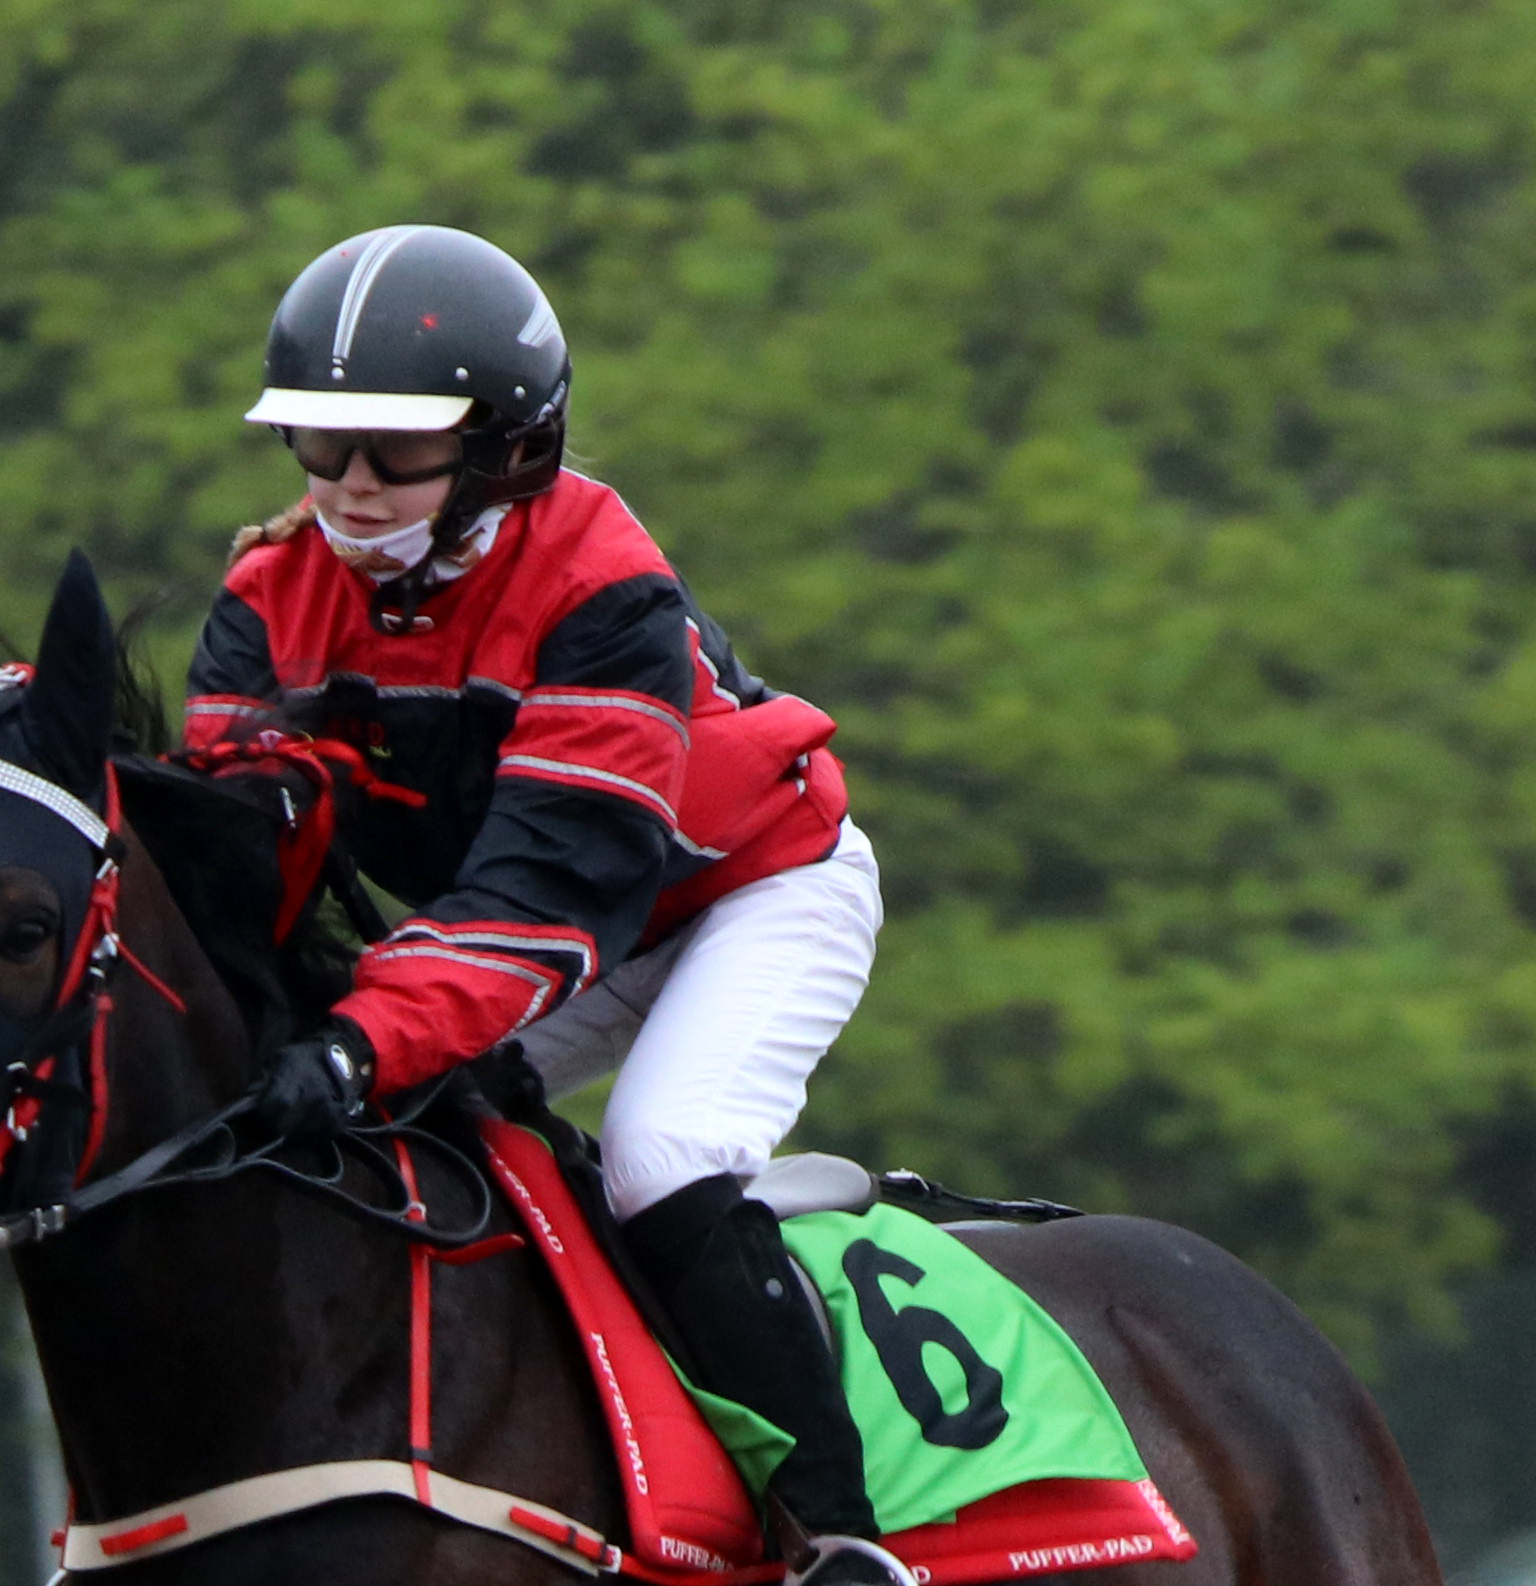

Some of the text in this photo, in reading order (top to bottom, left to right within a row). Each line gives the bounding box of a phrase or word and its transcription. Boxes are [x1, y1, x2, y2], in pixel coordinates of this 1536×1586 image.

[591, 1331, 649, 1495] PUFFER-PAD
[842, 1238, 1010, 1453] 6
[1009, 1535, 1153, 1571] PUFFER-PAD
